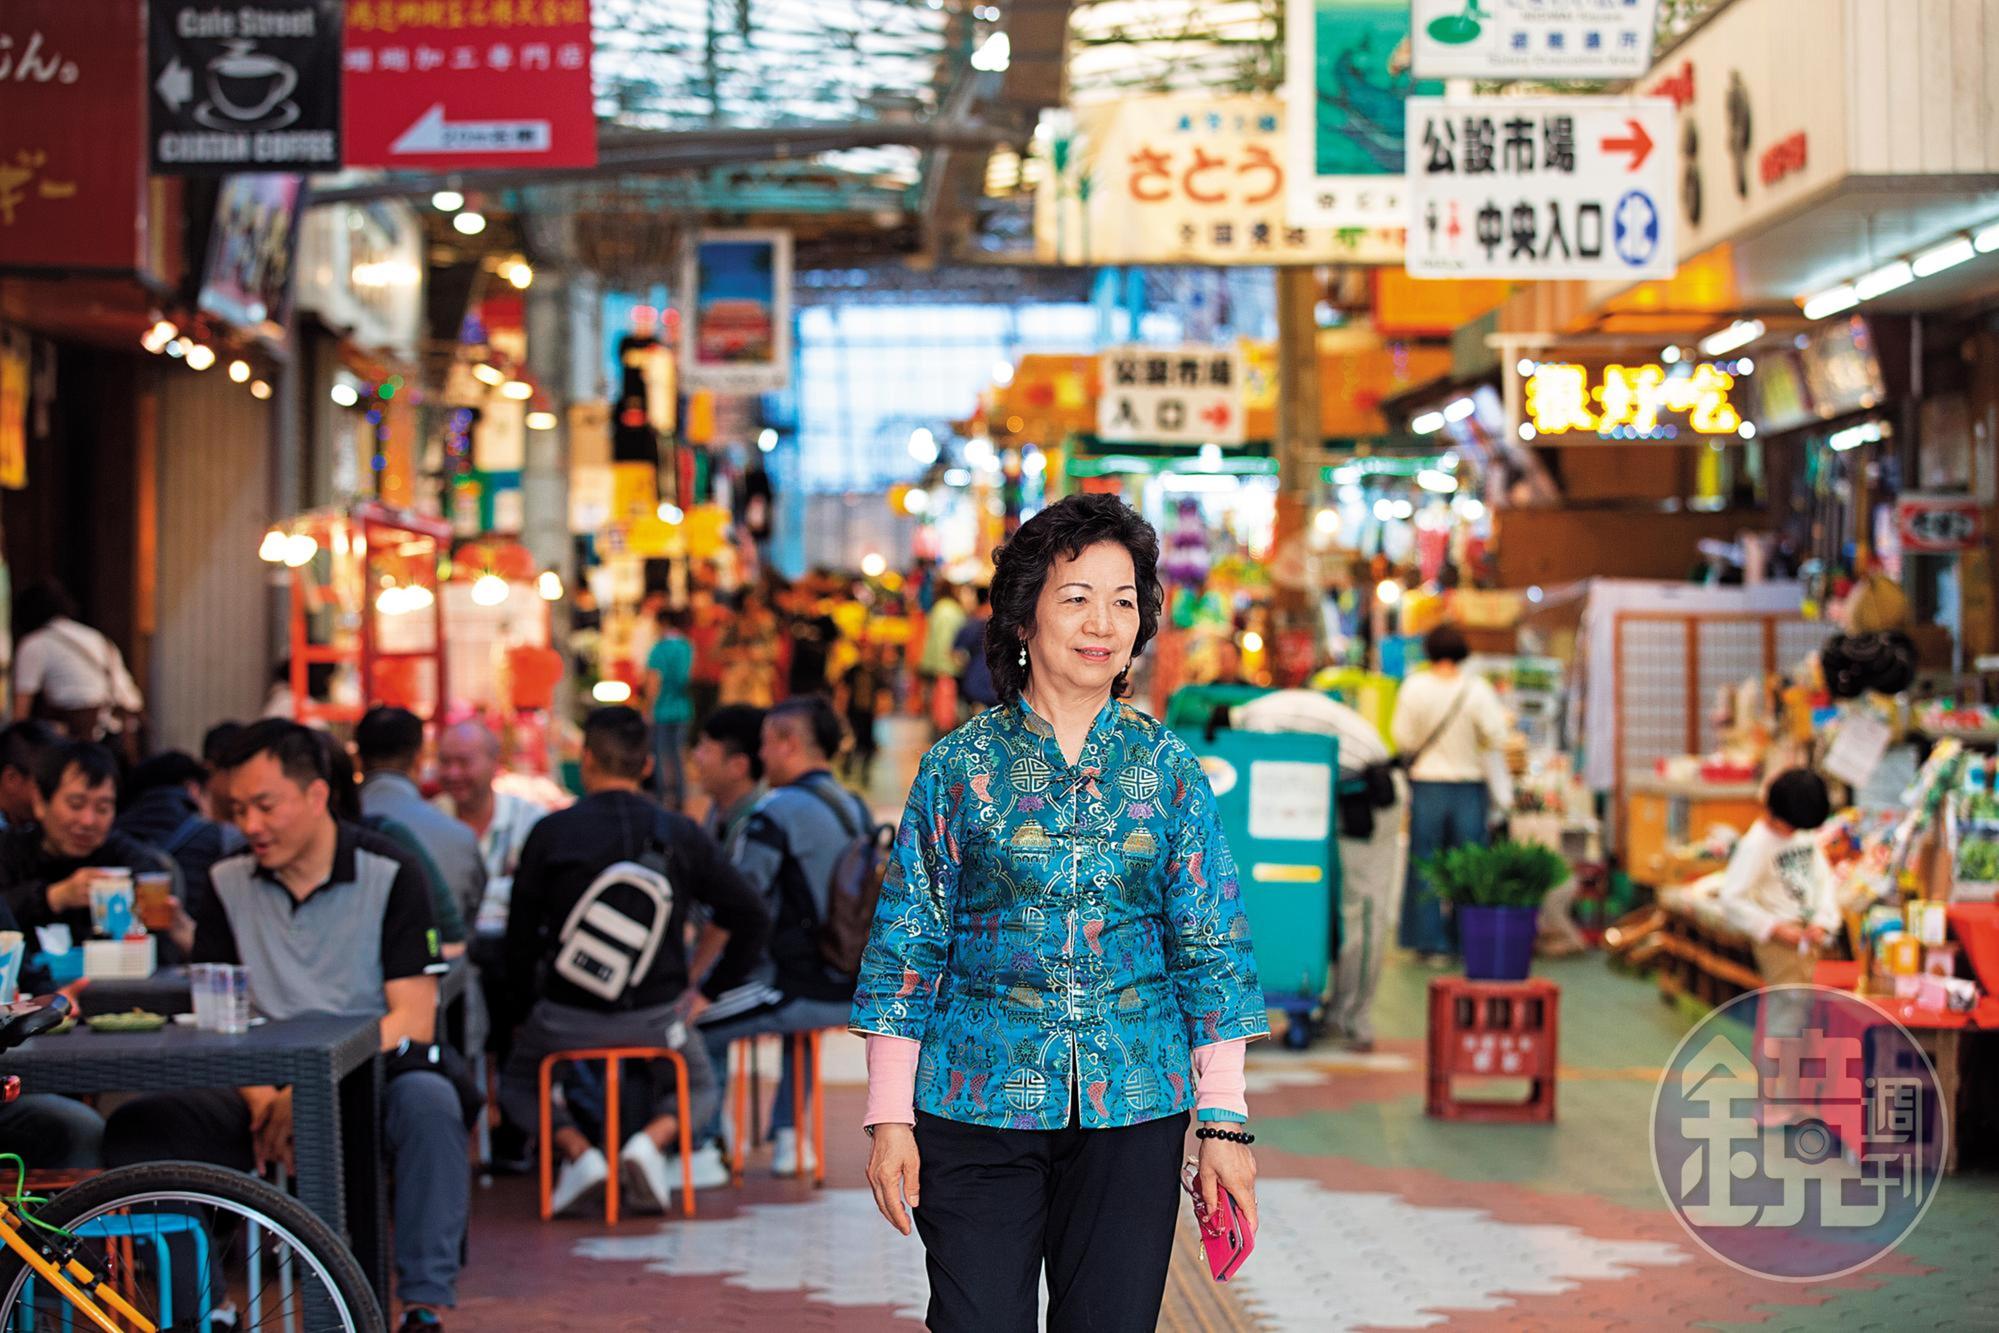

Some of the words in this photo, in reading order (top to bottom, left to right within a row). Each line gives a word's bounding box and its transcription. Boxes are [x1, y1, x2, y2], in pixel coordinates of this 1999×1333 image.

[1424, 116, 1576, 174] 公設市場
[1128, 146, 1283, 204] さとう
[1476, 200, 1602, 260] 中央入口
